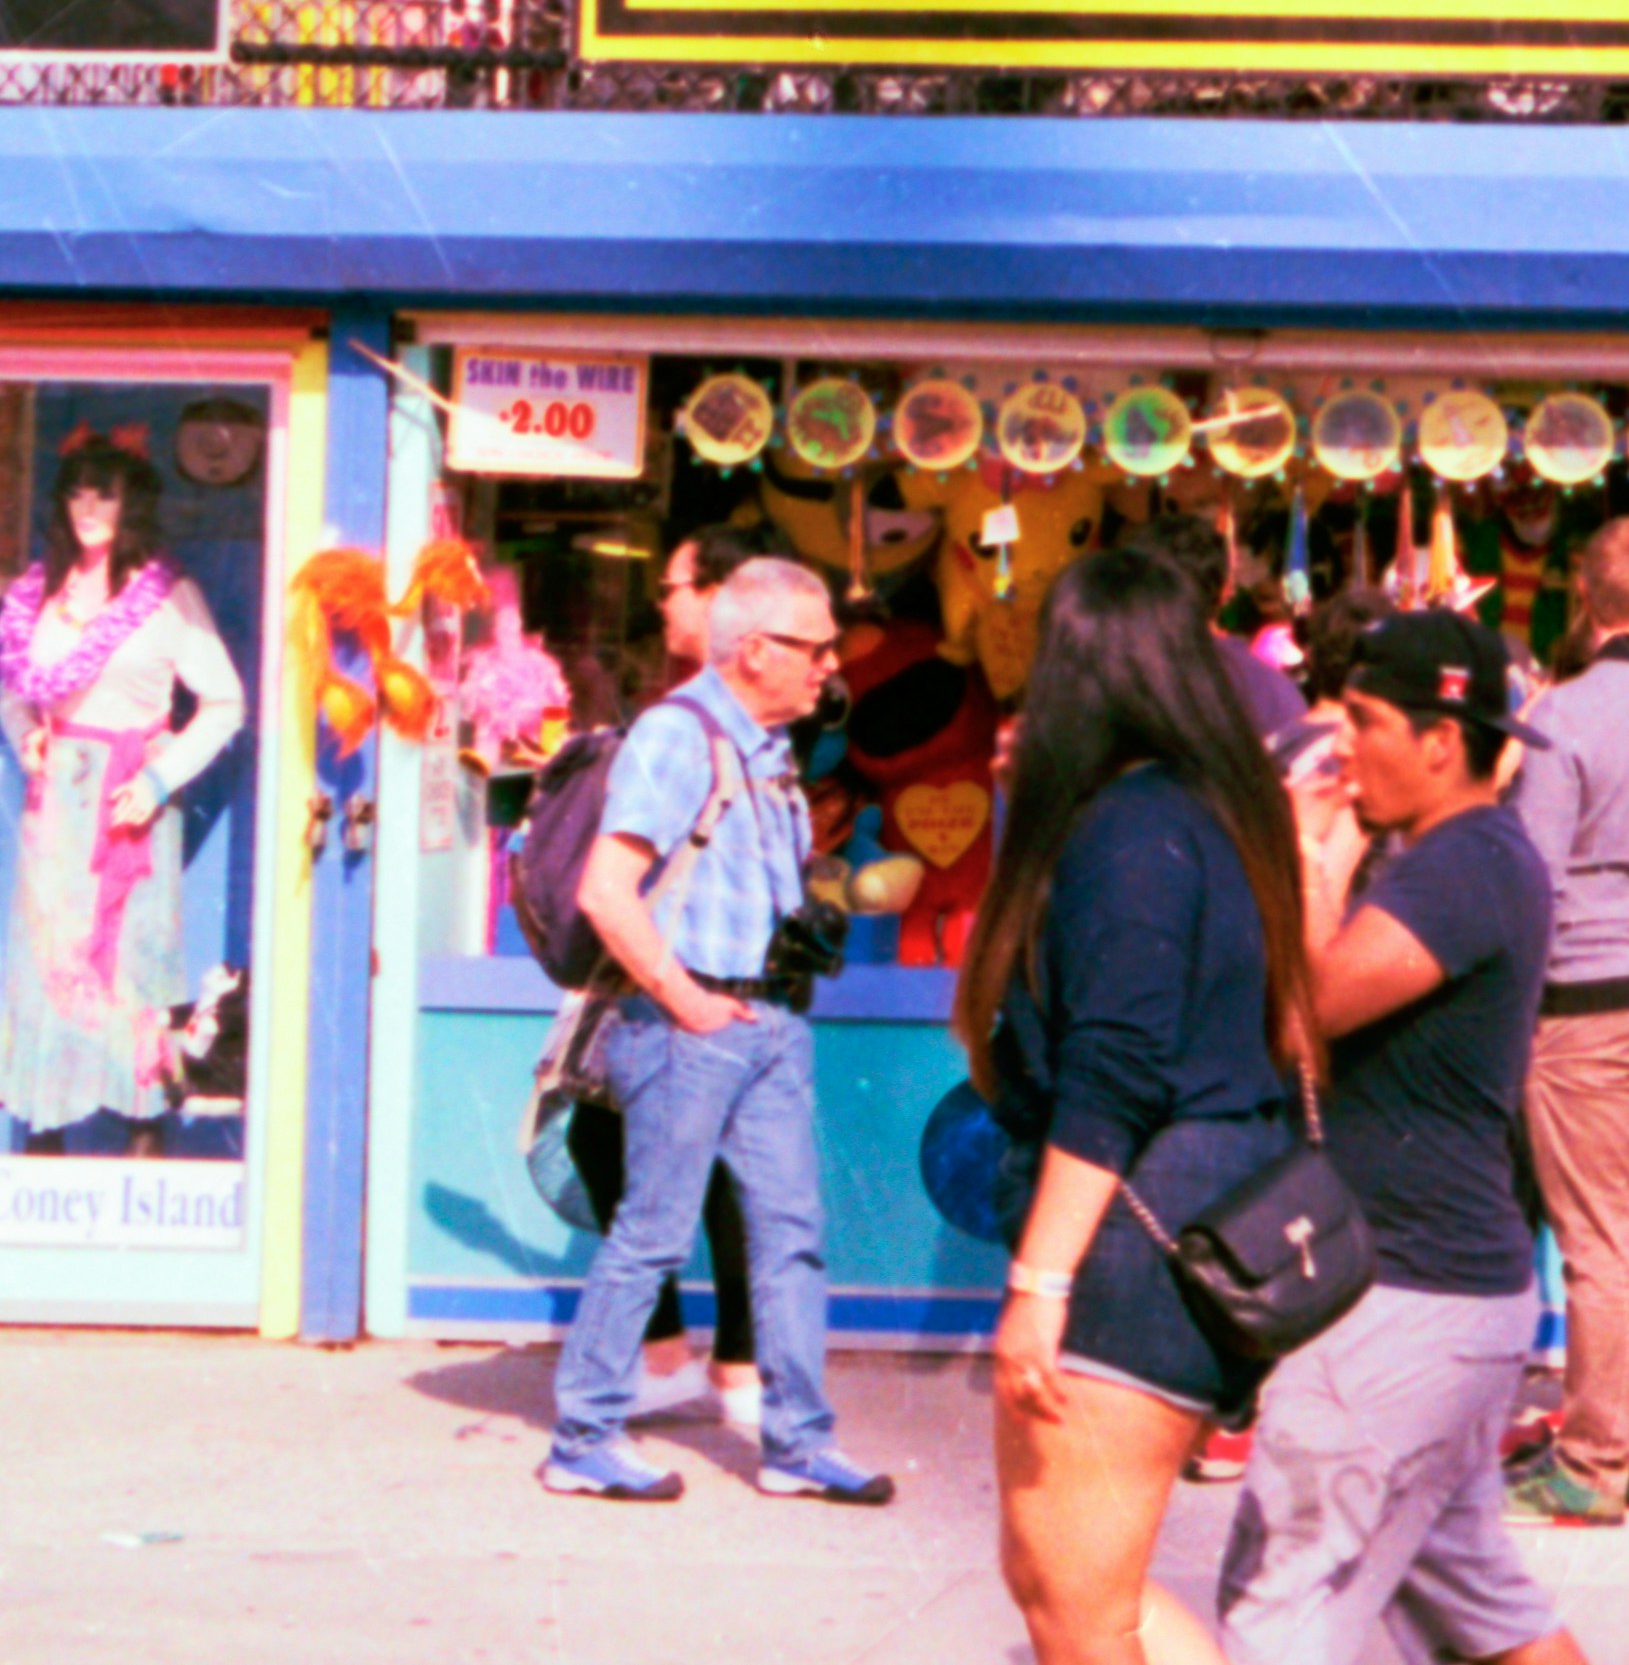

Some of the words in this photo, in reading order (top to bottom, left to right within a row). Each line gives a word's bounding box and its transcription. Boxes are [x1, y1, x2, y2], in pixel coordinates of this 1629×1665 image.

[466, 358, 521, 385] SKIN
[529, 360, 568, 388] the
[577, 365, 636, 393] WIRE
[121, 1174, 243, 1228] Island
